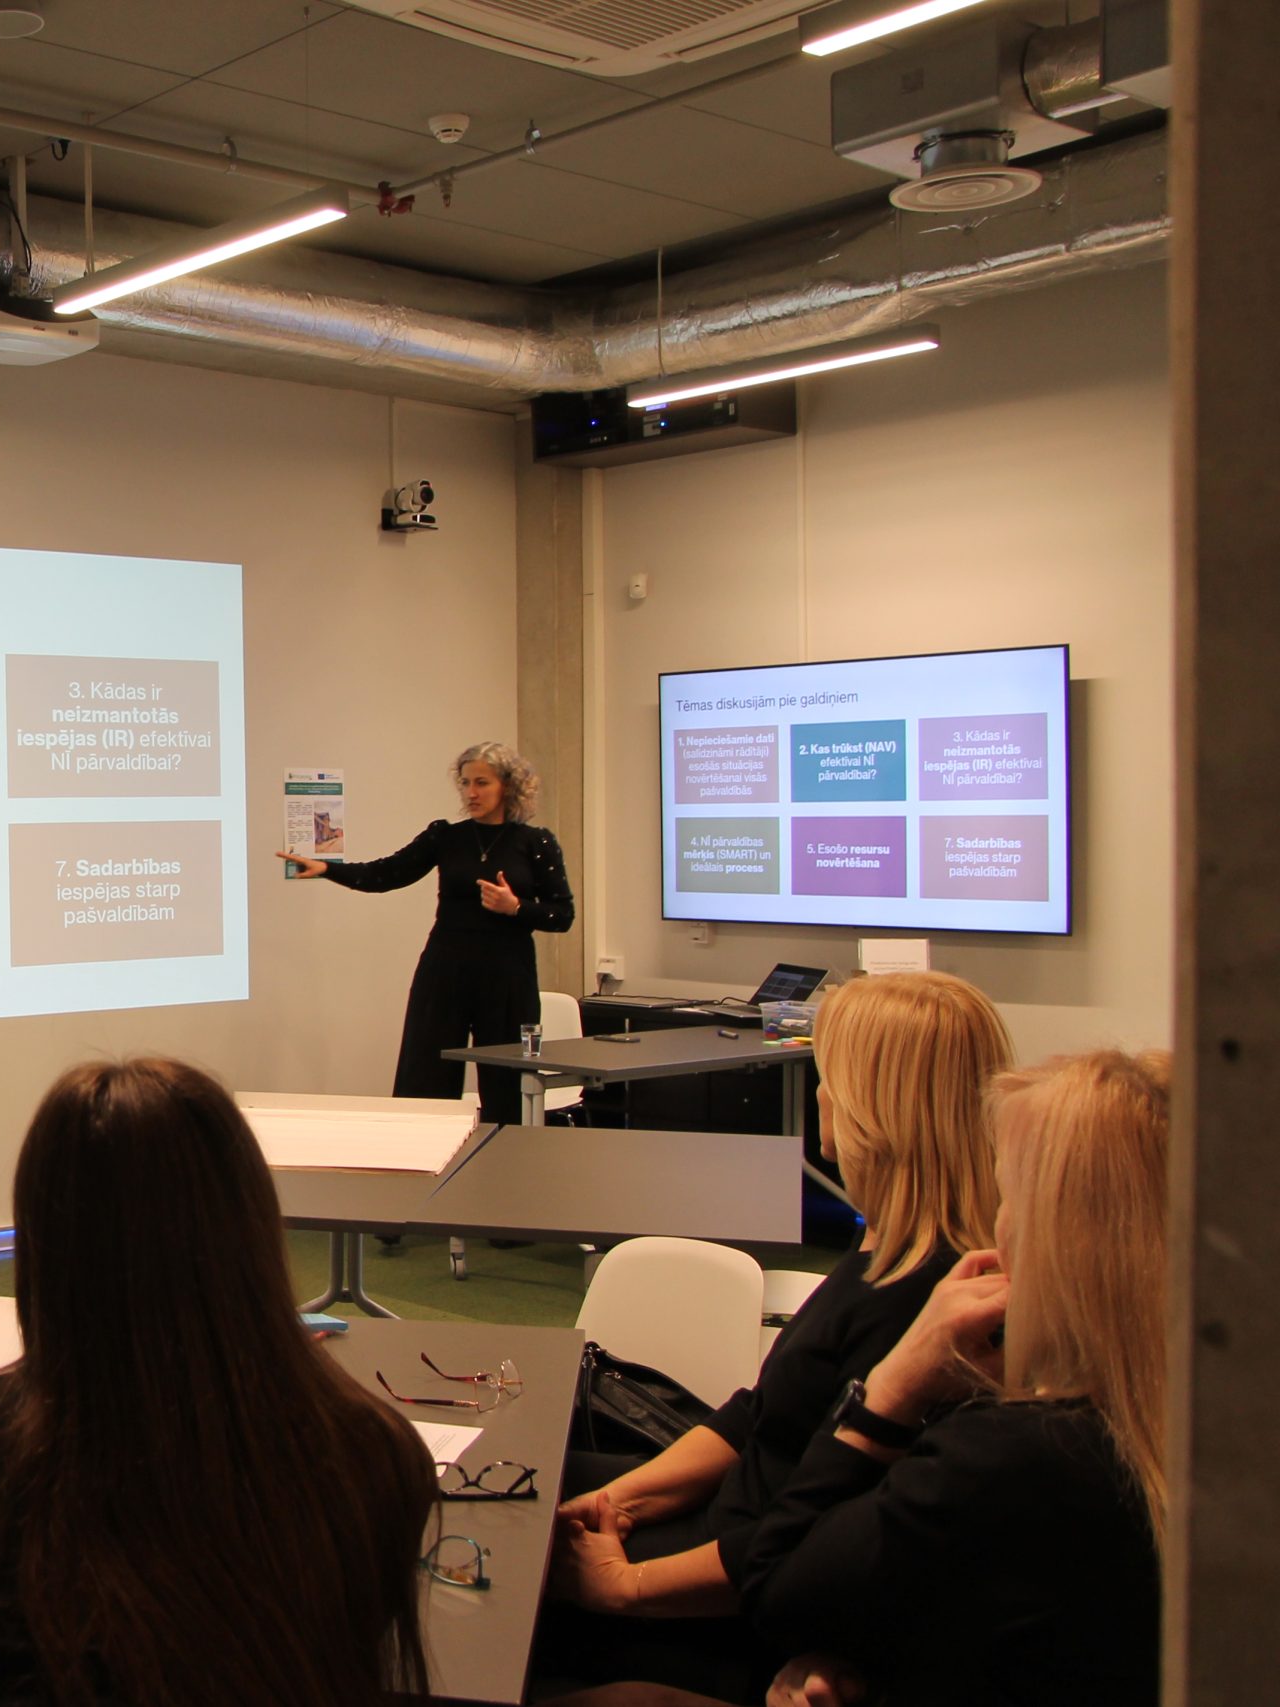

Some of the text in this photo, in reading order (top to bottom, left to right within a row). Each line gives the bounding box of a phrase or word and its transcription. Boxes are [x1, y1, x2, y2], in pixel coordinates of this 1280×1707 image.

[68, 682, 162, 701] 3. Kādas ir
[676, 700, 713, 712] Tēmas
[779, 694, 797, 709] pie
[801, 691, 858, 708] galdiņiem
[52, 707, 179, 725] neizmantotās
[17, 729, 212, 750] iespējas (IR) efektīvai
[756, 733, 775, 743] dati
[953, 732, 963, 742] 3.
[1003, 730, 1011, 740] ir
[800, 745, 808, 755] 2.
[811, 744, 830, 754] Kas
[865, 741, 896, 754] (NAV)
[51, 751, 181, 774] NĪ pārvaldībai?
[972, 759, 992, 771] (IR)
[690, 837, 699, 846] 4.
[944, 838, 954, 848] 7.
[716, 850, 757, 861] (SMART)
[807, 845, 816, 854] 5.
[850, 846, 890, 855] resursu
[992, 852, 1021, 864] starp
[56, 858, 181, 878] 7. Sadarbības
[726, 864, 763, 874] process
[56, 881, 181, 903] iespējas starp
[64, 904, 175, 927] pašvaldībām
